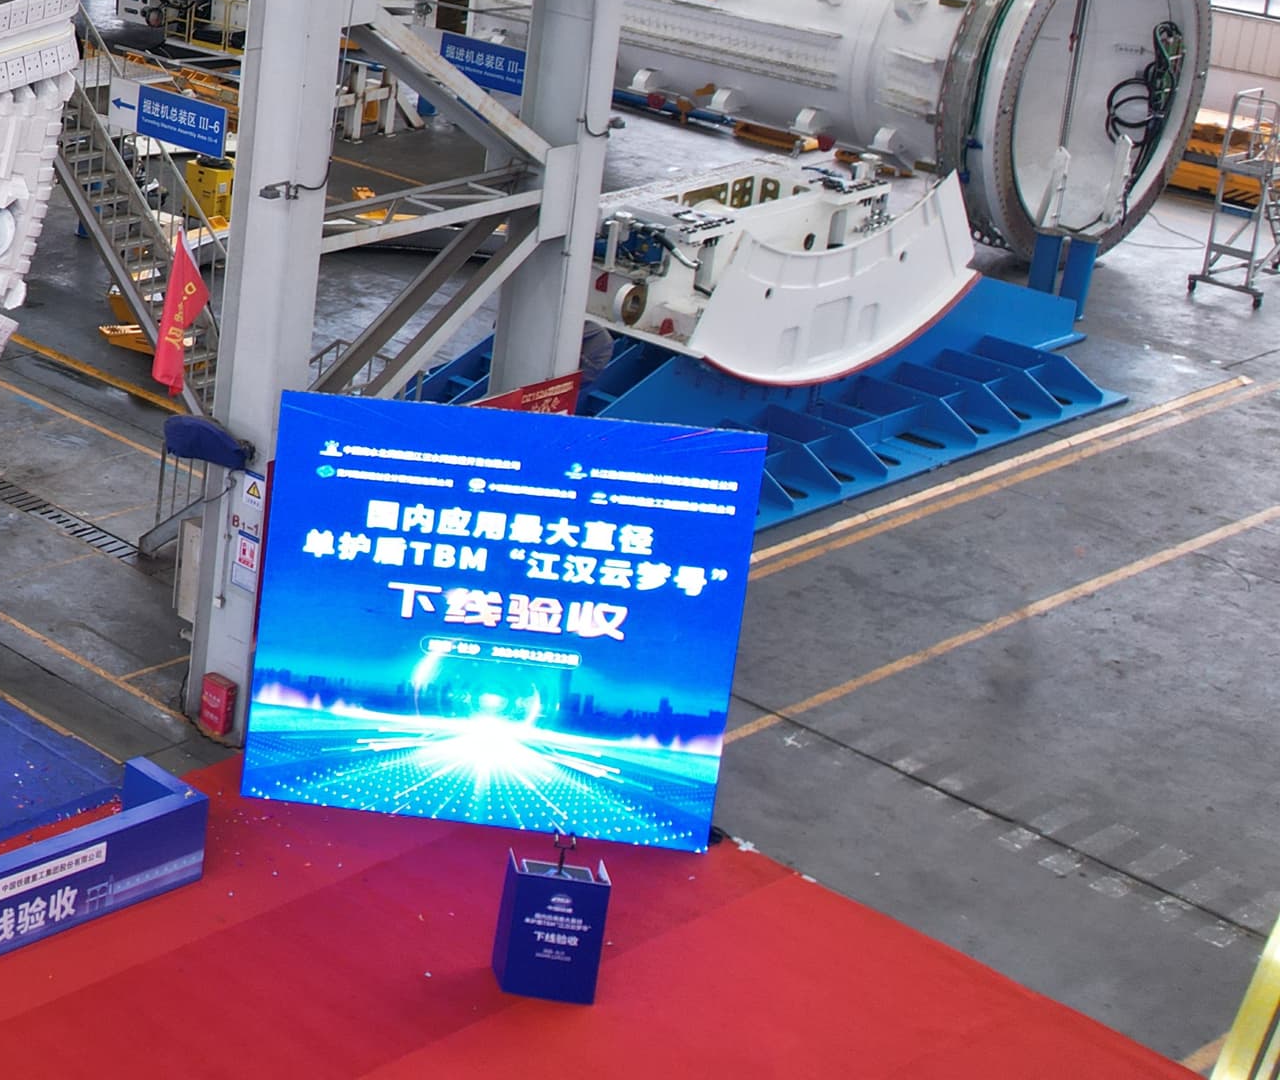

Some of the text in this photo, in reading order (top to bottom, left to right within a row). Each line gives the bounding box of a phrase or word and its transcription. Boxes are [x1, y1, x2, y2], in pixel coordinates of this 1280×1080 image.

[142, 98, 197, 128] 掘进机总装区
[302, 529, 488, 572] 单护盾TBM
[366, 499, 654, 555] 国内应用最大直径
[387, 580, 629, 641] 下线验收
